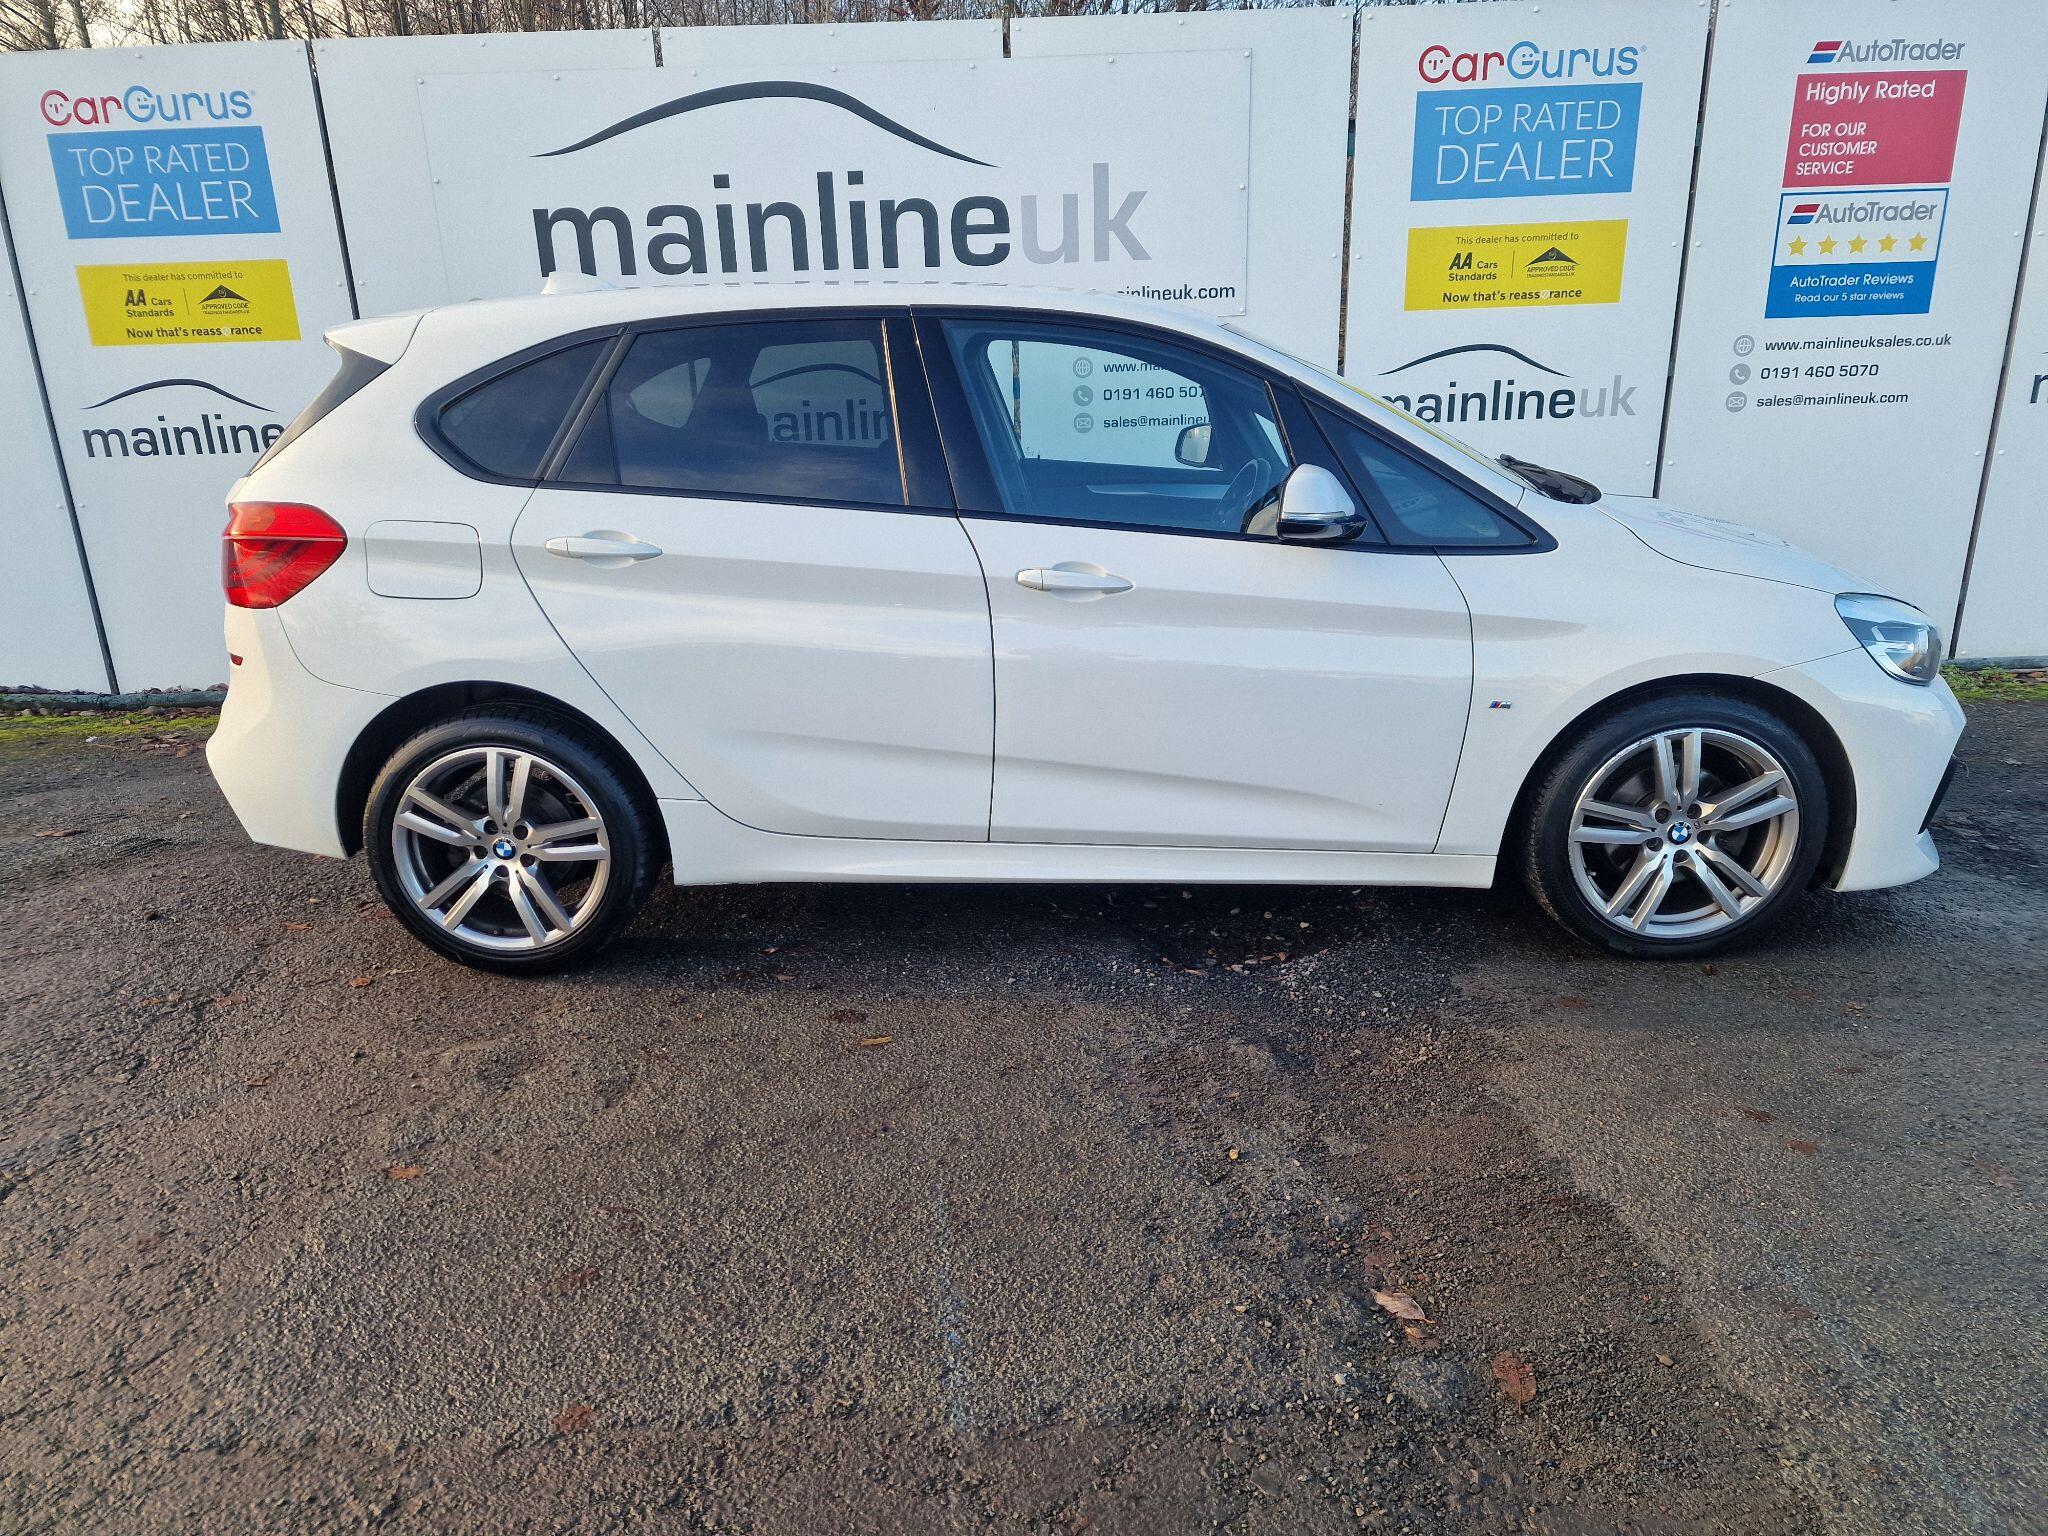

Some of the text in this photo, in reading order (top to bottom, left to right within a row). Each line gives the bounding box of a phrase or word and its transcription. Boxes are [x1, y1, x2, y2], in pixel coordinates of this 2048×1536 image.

[1837, 39, 1965, 62] AutoTrader
[1418, 41, 1638, 83] CarGurus
[1806, 80, 1936, 105] Highly Rated
[40, 85, 253, 126] CarGurus
[1435, 100, 1622, 136] TOP RATED
[1801, 122, 1867, 138] FOR OUR
[1799, 141, 1878, 156] CUSTOMER
[68, 142, 250, 177] TOP RATED
[1436, 138, 1615, 185] DEALER
[1796, 161, 1854, 176] SERVICE
[81, 180, 259, 224] DEALER
[1815, 201, 1938, 224] AutoTrader
[1456, 232, 1579, 245] This dealer has committed to
[1449, 252, 1498, 270] AA Cars
[123, 271, 243, 282] This dealer has committed to
[1448, 272, 1497, 282] Standards
[1790, 273, 1914, 288] AutoTrader Reviews
[125, 289, 172, 306] AA Cars
[1442, 289, 1582, 302] Now that's reassrance
[1795, 291, 1905, 302] Read our 5 star reviews
[126, 308, 174, 318] Standards
[126, 326, 262, 338] Now that's reassrance
[1764, 333, 1952, 351] www.mainlineuksales.co.uk
[1760, 364, 1879, 380] 0191 460 5070
[1103, 388, 1140, 401] 0191
[1145, 387, 1175, 399] 460
[1756, 392, 1909, 407] sales@mainlineuk.com
